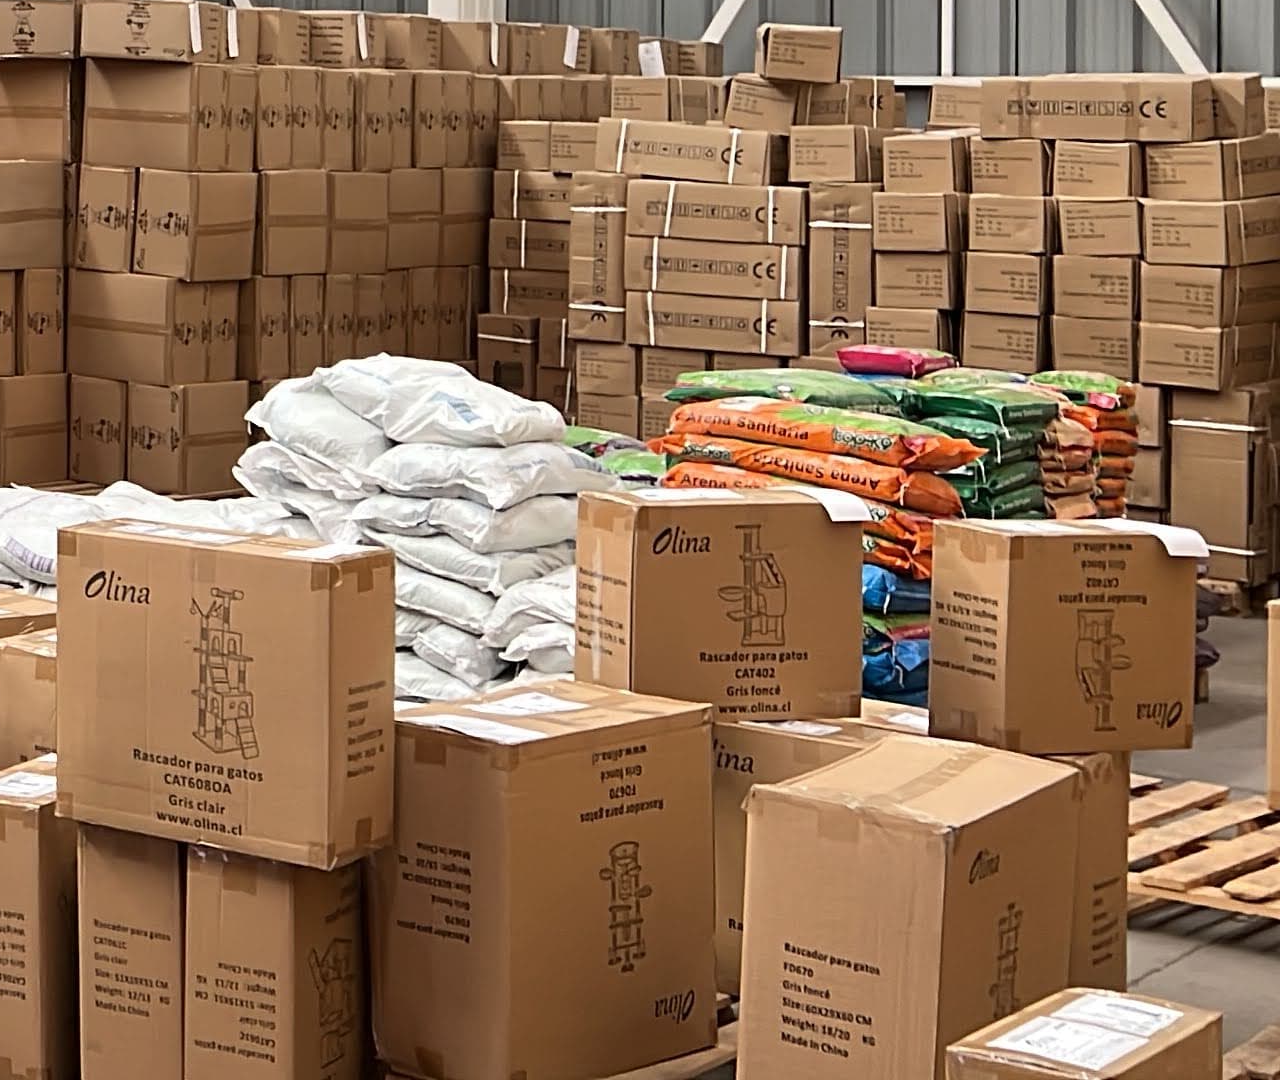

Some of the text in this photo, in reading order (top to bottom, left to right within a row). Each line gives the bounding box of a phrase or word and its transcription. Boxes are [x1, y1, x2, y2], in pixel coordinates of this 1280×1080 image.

[1138, 99, 1168, 119] CE
[753, 262, 776, 280] CE
[680, 473, 727, 489] Arena
[831, 469, 880, 491] Arena
[652, 526, 711, 556] Olina
[84, 570, 151, 606] Olina
[700, 651, 809, 664] Rascador para gatos
[735, 667, 776, 679] CAT402
[726, 684, 781, 697] Gris foncé
[719, 701, 791, 714] www.olina.cl
[1136, 699, 1183, 729] Olina
[133, 748, 264, 782] Rascador para gatos
[713, 736, 755, 775] ina
[168, 794, 226, 815] Gris clair
[156, 810, 243, 836] www.olina.cl
[969, 849, 1000, 885] Olina
[783, 961, 814, 978] FD670
[784, 942, 880, 976] Rascador para gatos
[782, 979, 802, 994] Gris
[655, 989, 695, 1024] Olina
[781, 1014, 819, 1032] Weight:
[855, 1014, 873, 1026] CM
[781, 1031, 849, 1059] Made in China
